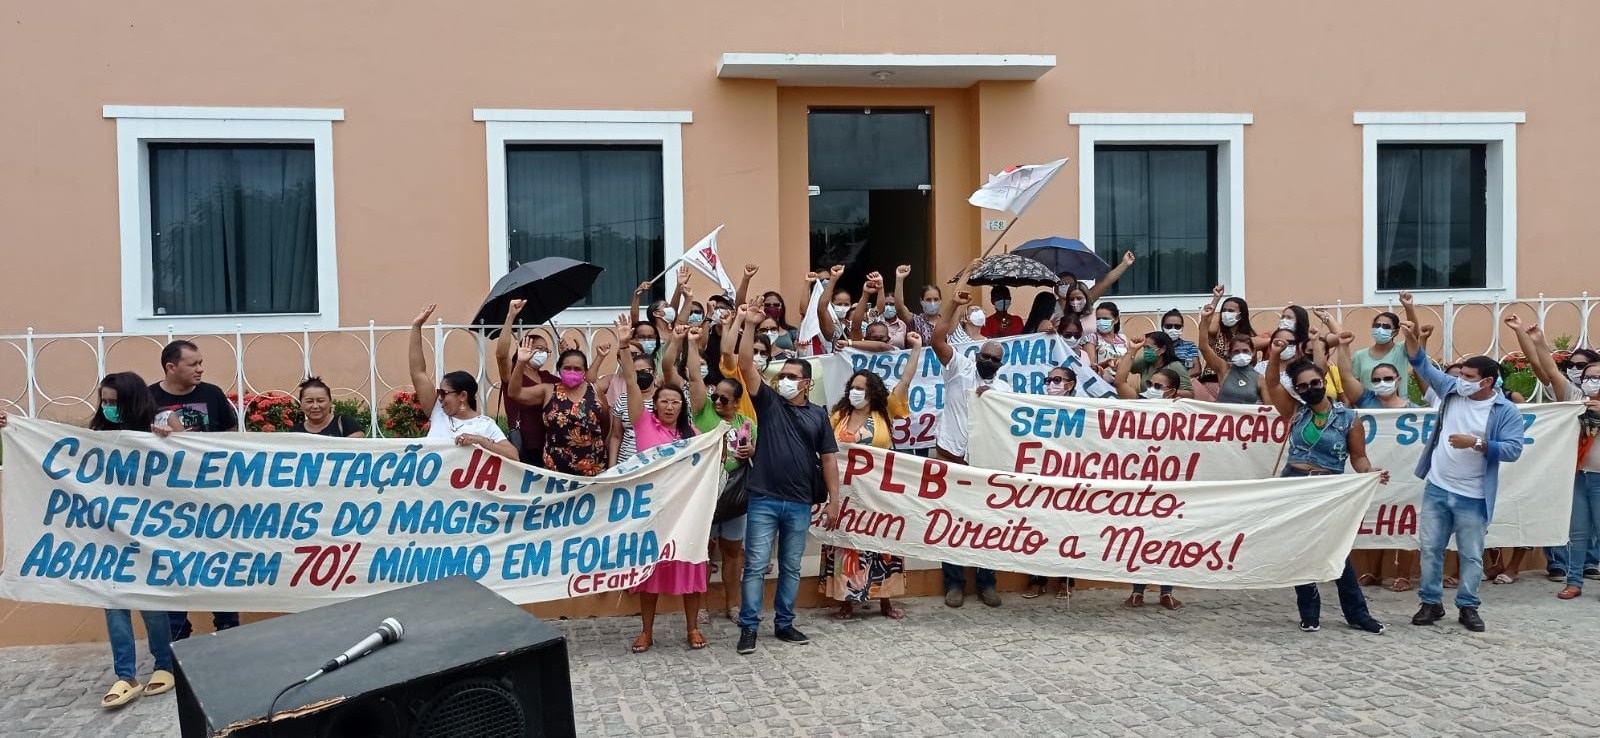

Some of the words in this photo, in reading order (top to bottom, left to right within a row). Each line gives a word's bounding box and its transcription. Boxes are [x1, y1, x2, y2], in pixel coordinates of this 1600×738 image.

[891, 413, 936, 446] 3,2
[1010, 407, 1085, 438] SEM
[1098, 406, 1288, 450] VALORIZAÇÃO
[42, 437, 442, 494] COMPLEMENTAÇÃO
[43, 488, 323, 540] PROFISSIONAIS
[331, 501, 382, 537] DO
[388, 493, 595, 535] MAGISTÉRIO
[608, 483, 653, 523] DE
[986, 473, 1186, 519] Sindicato.
[20, 533, 140, 584] ABARÉ
[146, 549, 282, 588] EXIGEM
[290, 542, 361, 592] 70%
[367, 541, 490, 584] MÍNIMO
[502, 540, 550, 580] EM
[561, 530, 659, 576] FOLHA
[923, 509, 1049, 555] Direito
[1058, 535, 1086, 560] a
[1100, 525, 1245, 573] Menos!
